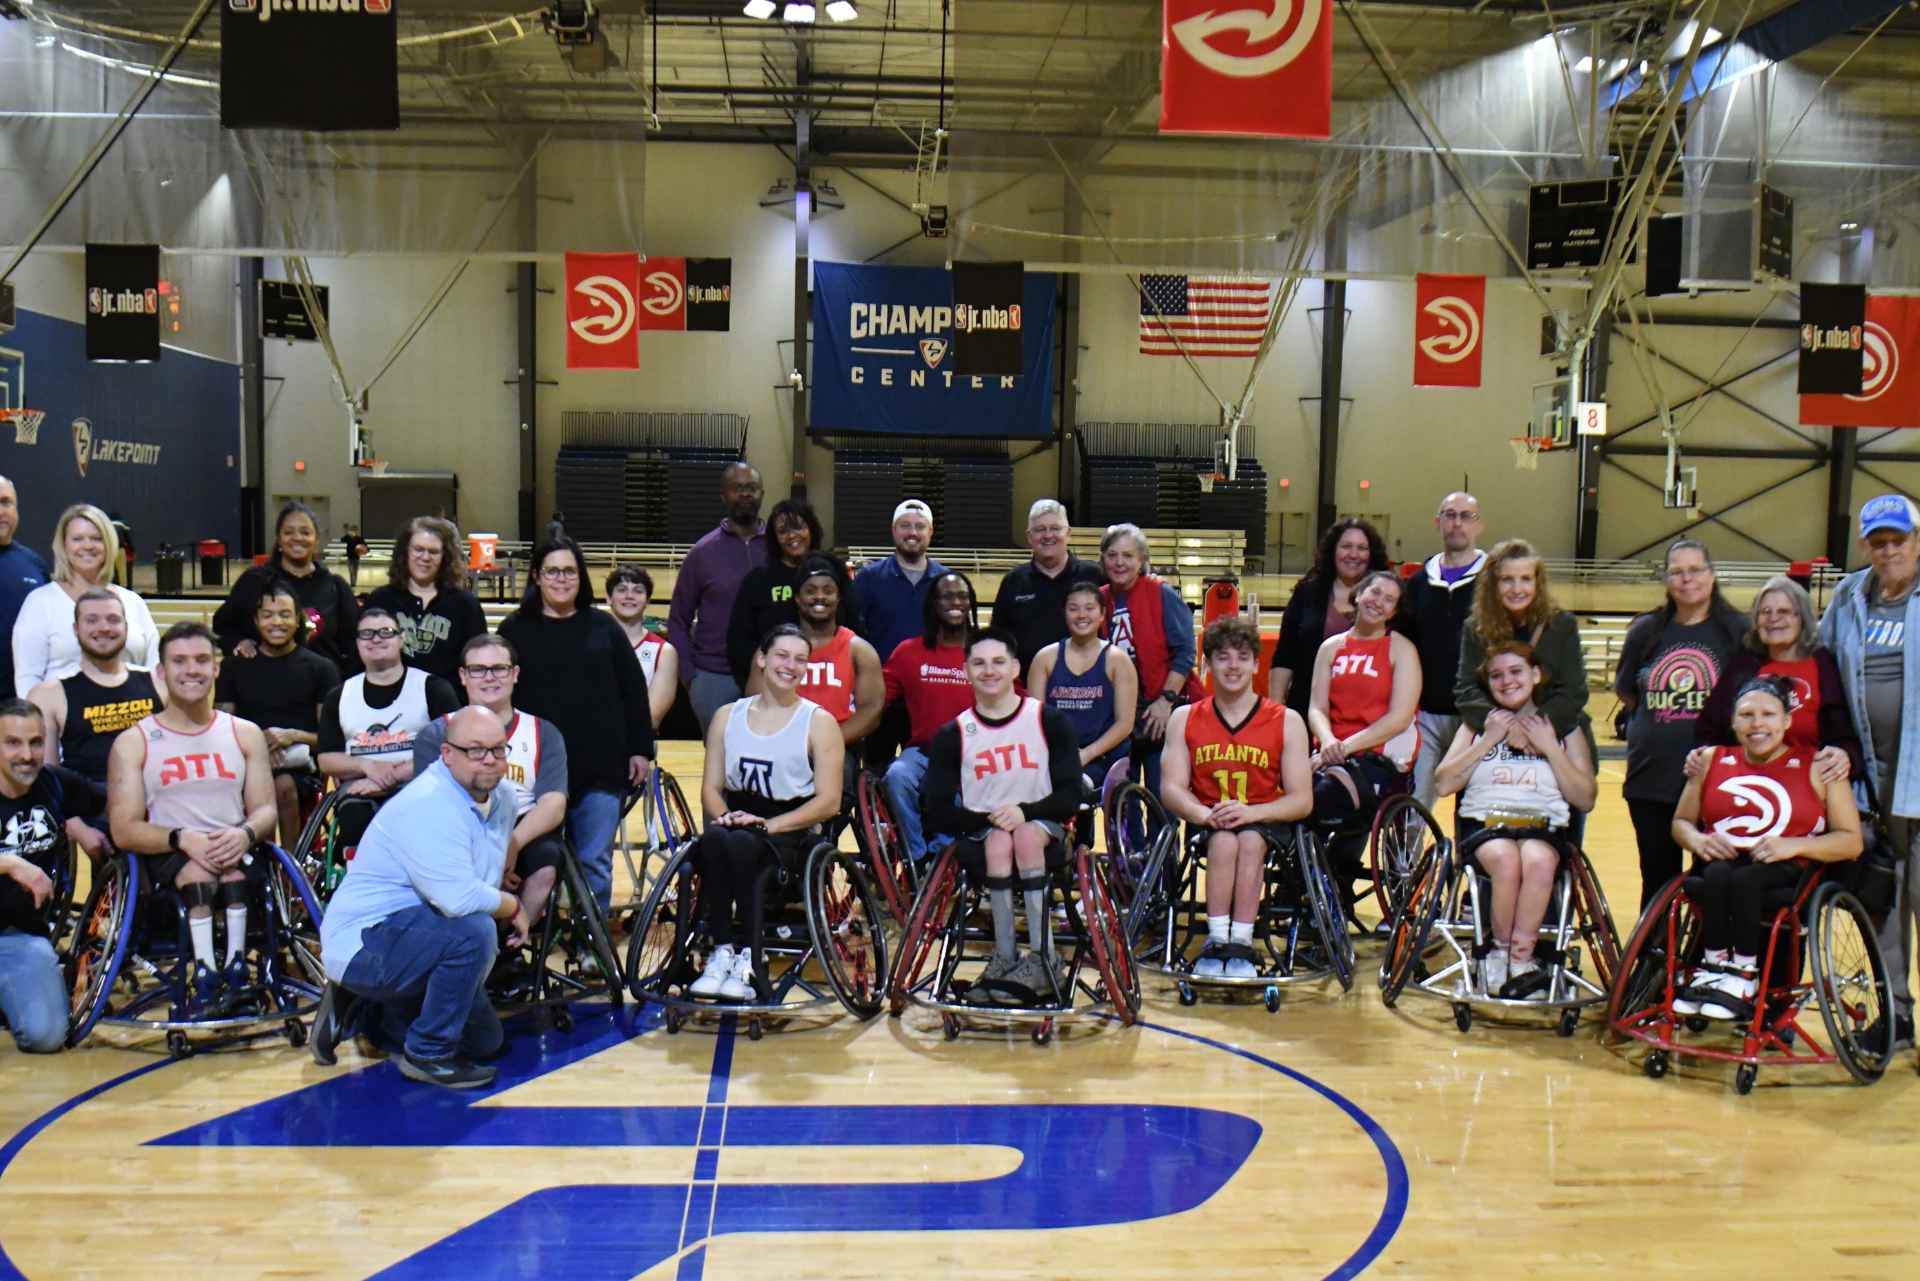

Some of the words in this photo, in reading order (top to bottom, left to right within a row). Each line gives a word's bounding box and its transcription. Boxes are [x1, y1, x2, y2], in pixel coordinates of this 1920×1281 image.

[101, 288, 143, 317] jr.nba
[850, 302, 952, 339] CHAMP
[966, 304, 1008, 333] jr.nba
[1811, 324, 1850, 352] jr.nba
[1587, 409, 1598, 428] 8
[92, 438, 161, 465] LAKEPOINT
[1331, 654, 1379, 678] ATL
[83, 698, 154, 720] MIZZOU
[160, 753, 237, 786] ATL
[974, 743, 1040, 781] ATL
[1195, 743, 1270, 768] ATLANTA
[1213, 769, 1249, 805] 11
[1491, 765, 1538, 792] 24
